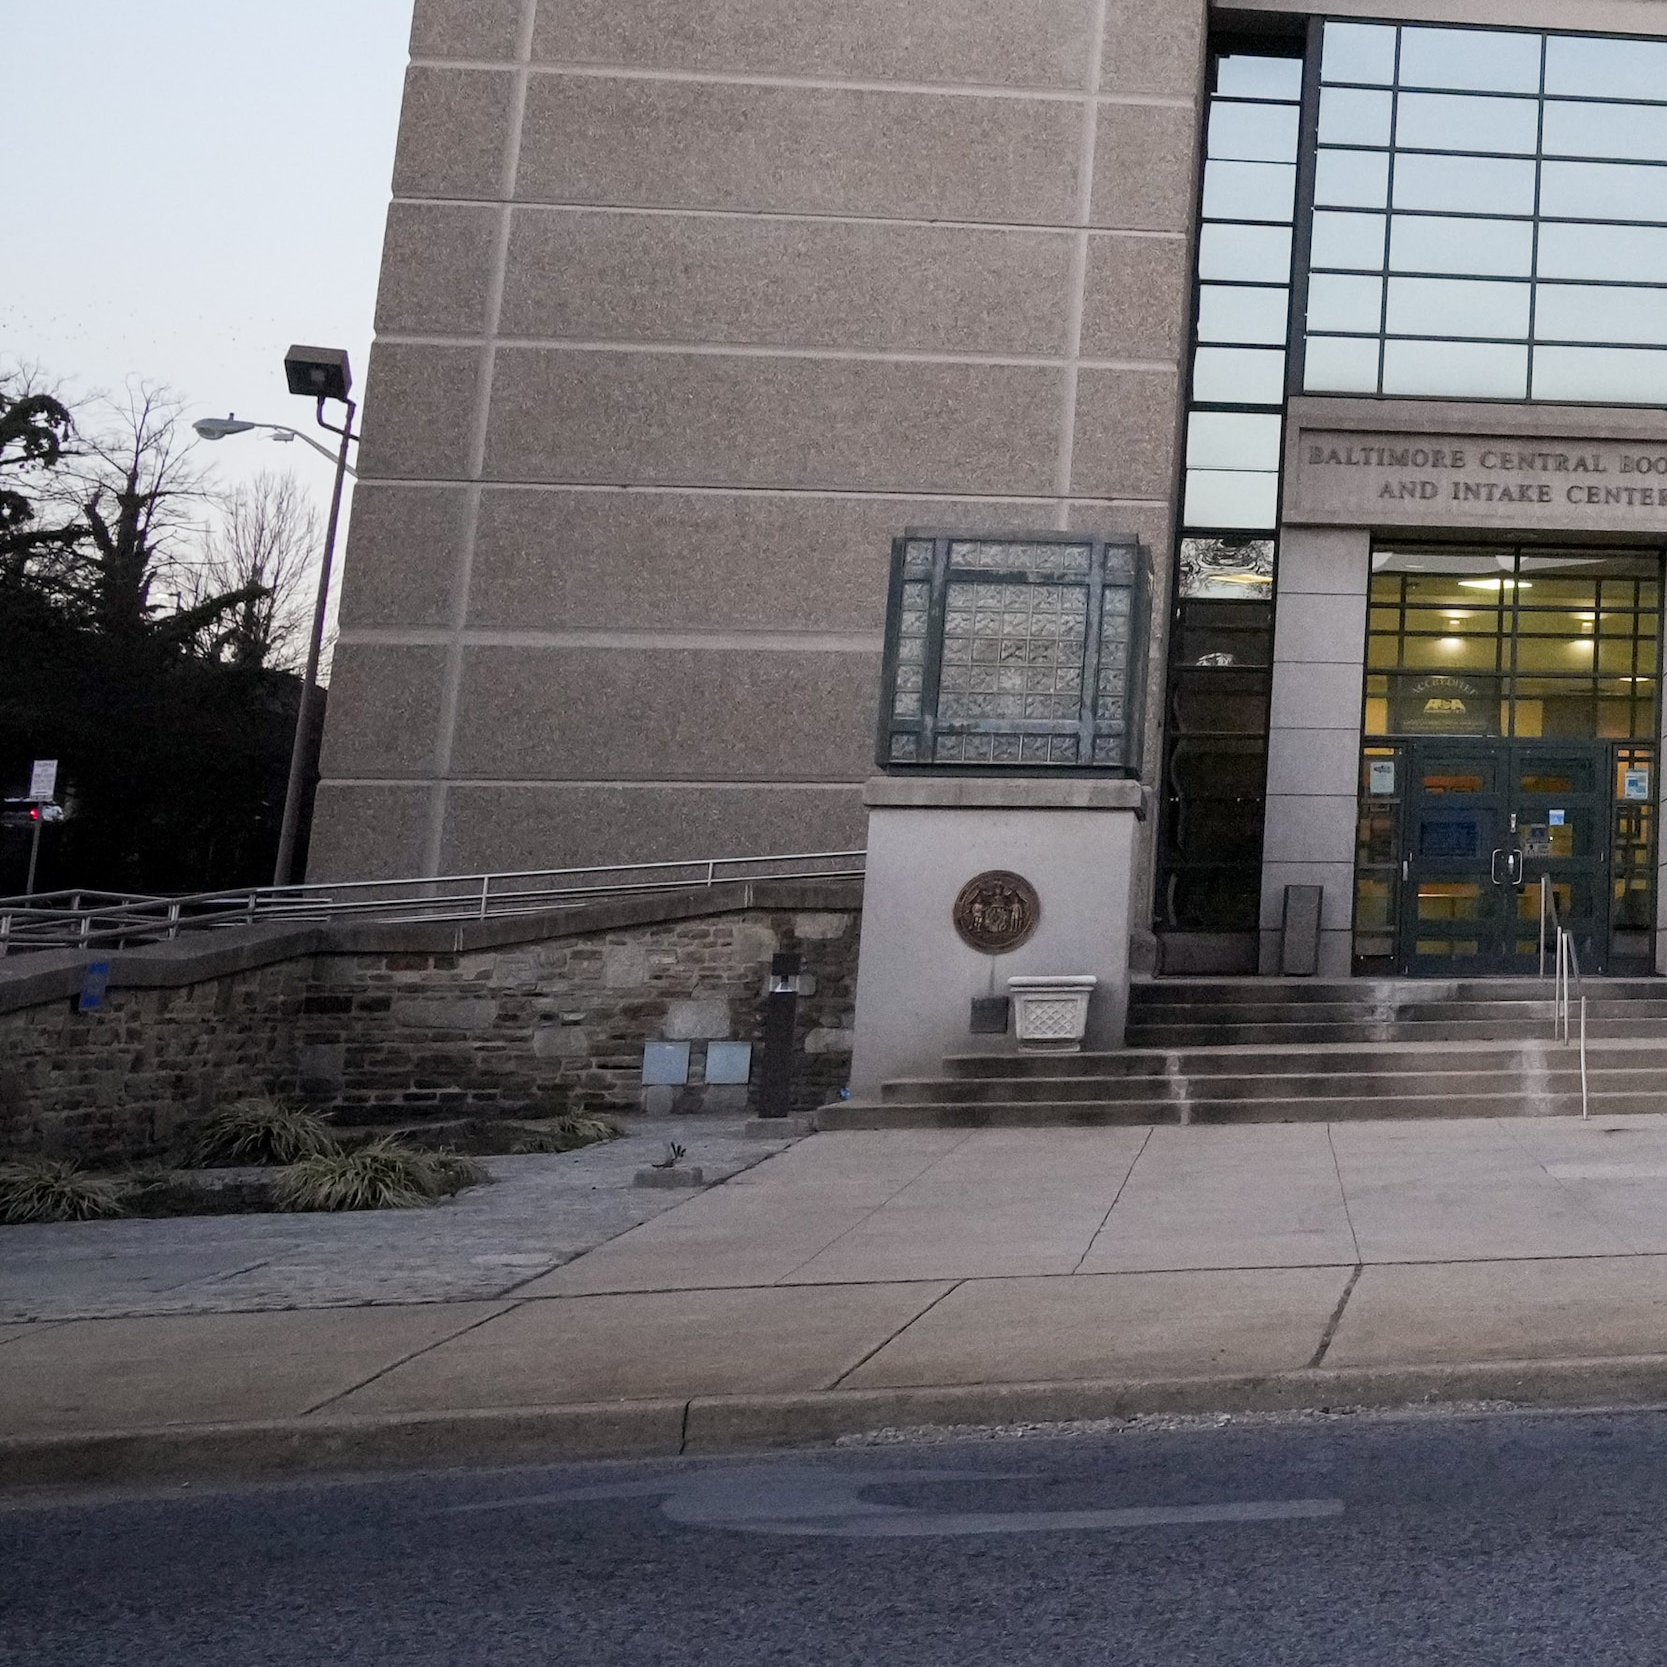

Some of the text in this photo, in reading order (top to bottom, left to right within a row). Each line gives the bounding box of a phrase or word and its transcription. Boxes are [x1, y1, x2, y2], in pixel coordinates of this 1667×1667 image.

[1307, 445, 1466, 469] BALTIMORE
[1480, 450, 1607, 473] CENTRAL
[1378, 479, 1438, 500] AND
[1452, 482, 1551, 503] INTAKE
